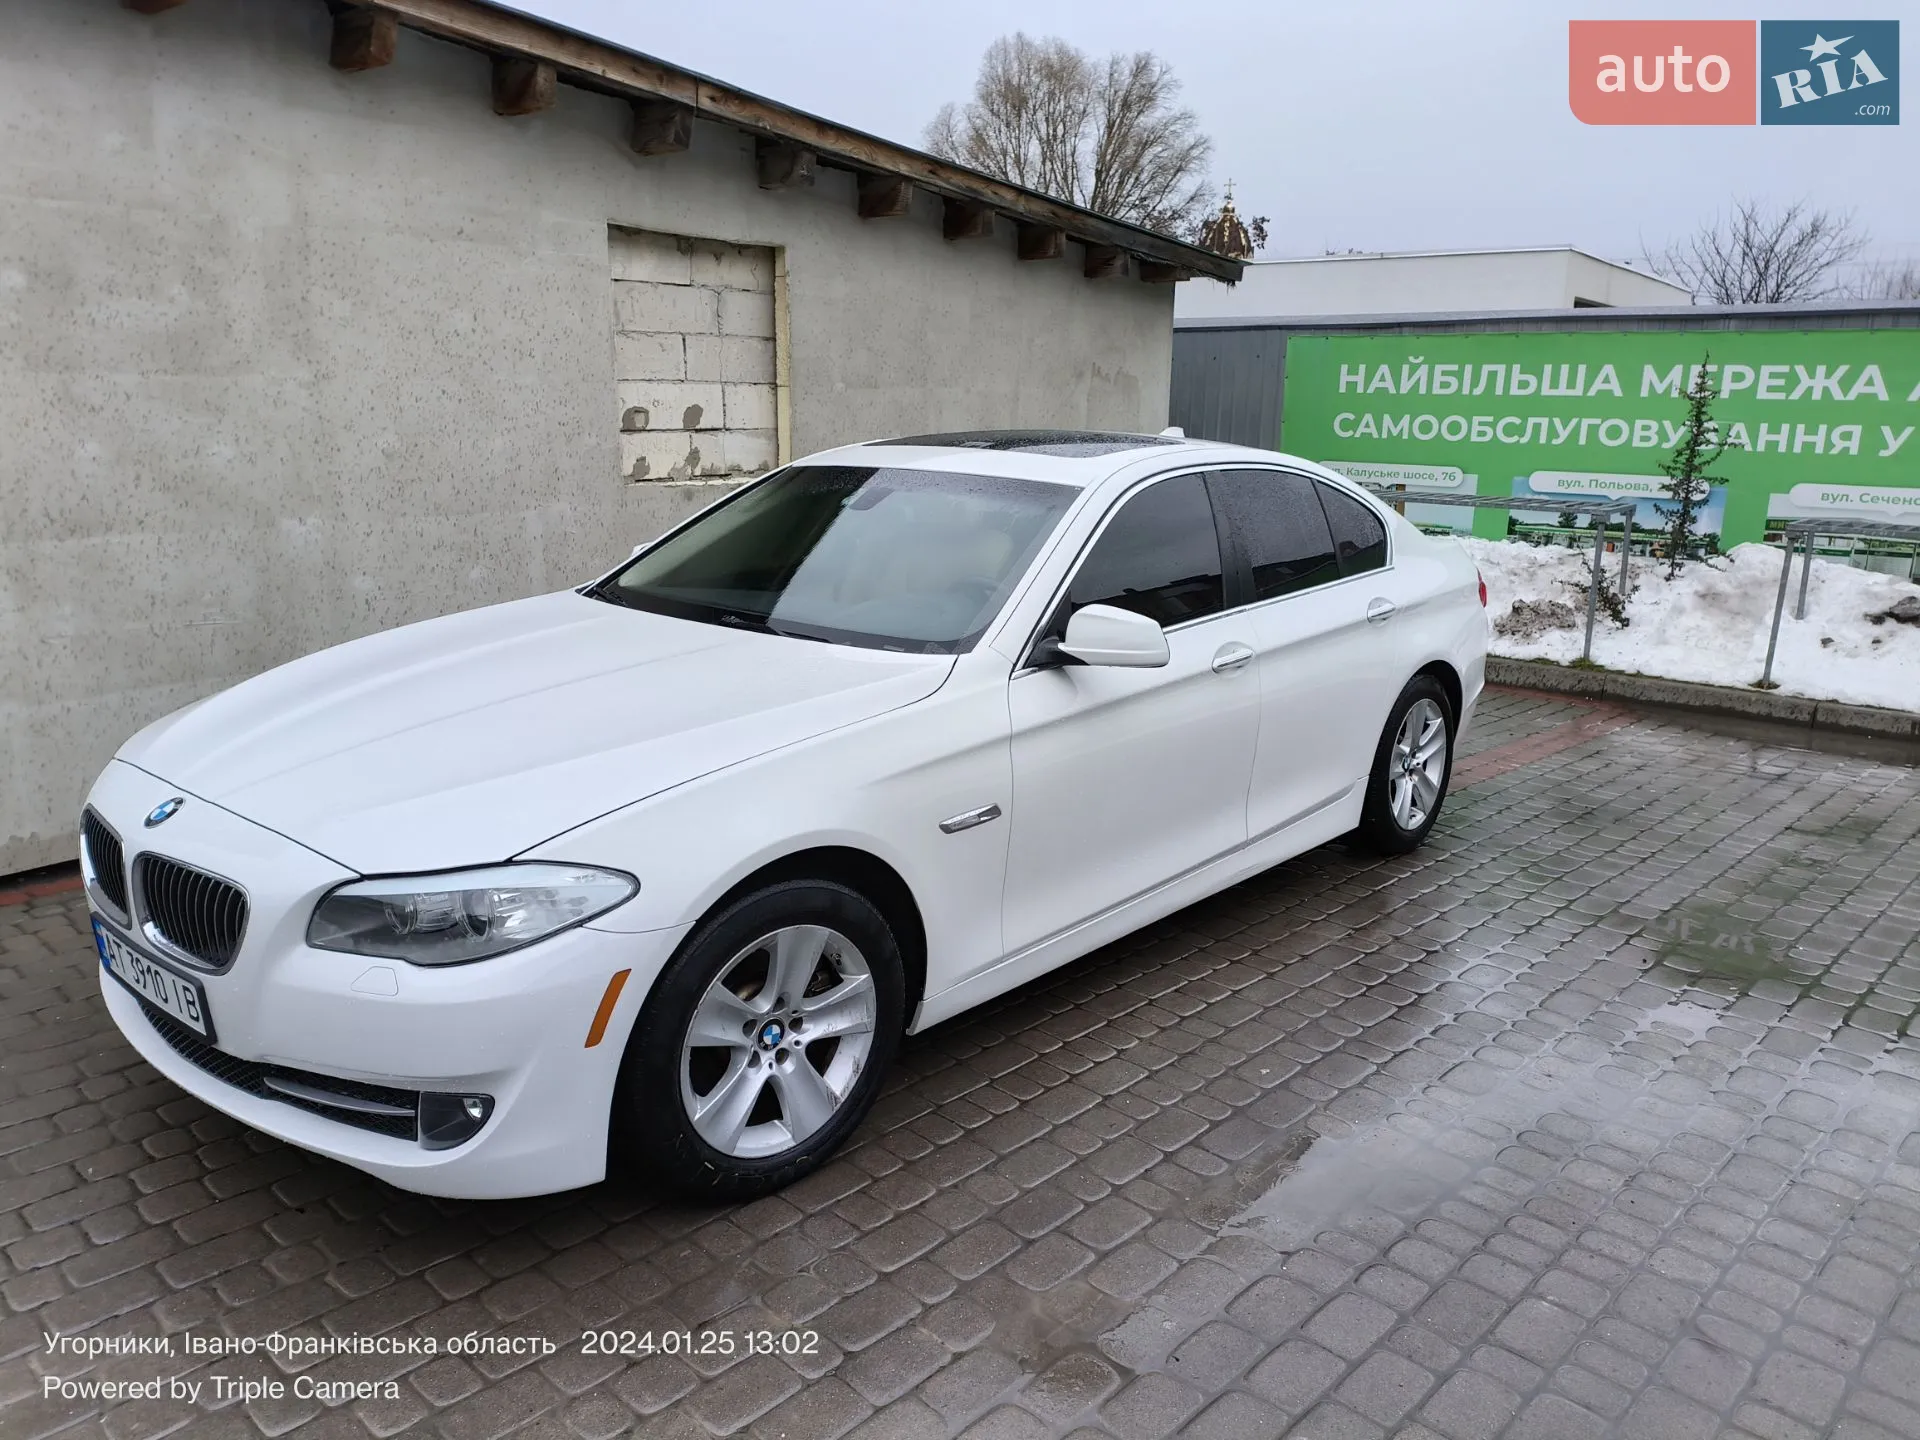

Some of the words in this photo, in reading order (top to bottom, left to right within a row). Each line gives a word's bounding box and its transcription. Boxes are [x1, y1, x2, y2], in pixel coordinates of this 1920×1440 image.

[1338, 356, 1623, 397] НАЙБІЛЬША
[1639, 364, 1889, 401] МЕРЕЖА
[1878, 425, 1916, 457] У
[1346, 467, 1400, 481] Калуське
[1404, 471, 1438, 482] шосе,
[1557, 478, 1584, 490] вул.
[1589, 478, 1652, 493] Польова,
[1821, 492, 1853, 504] вул.
[105, 934, 126, 974] AT
[126, 949, 168, 1004] 3910
[172, 979, 200, 1022] IB
